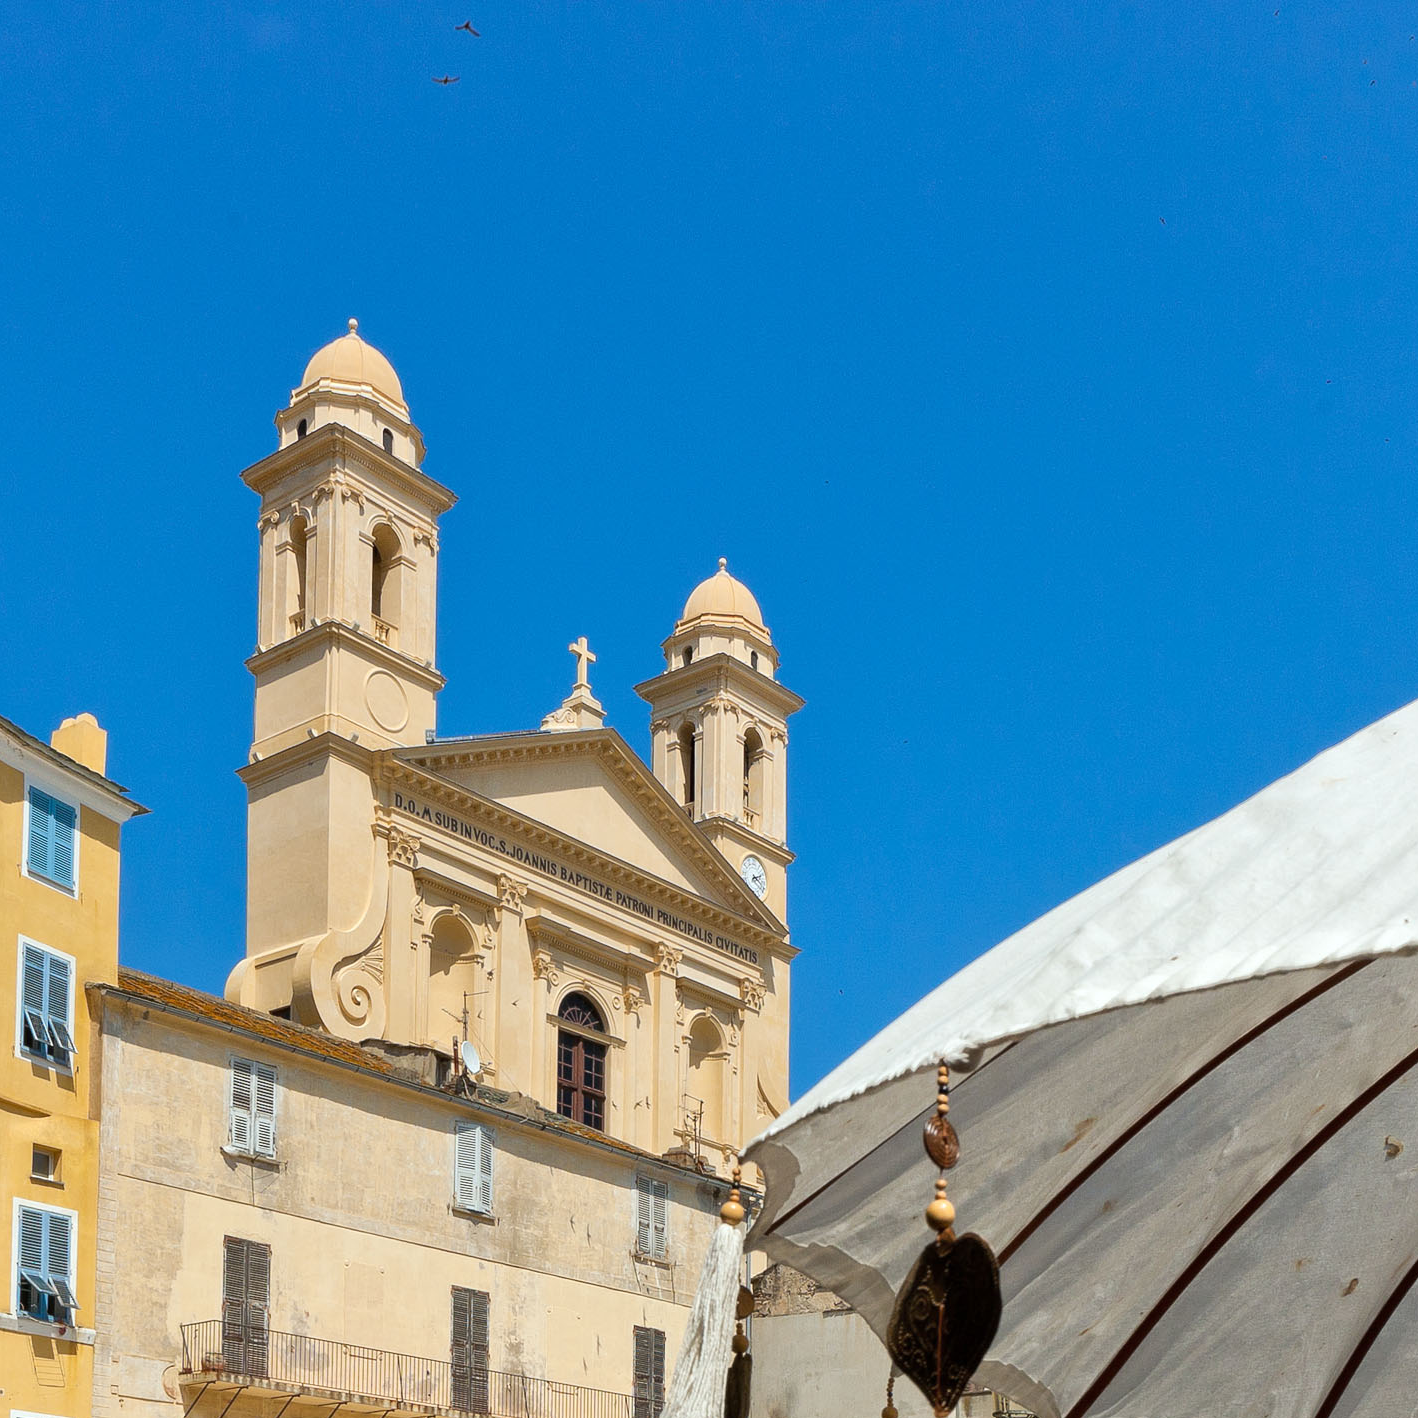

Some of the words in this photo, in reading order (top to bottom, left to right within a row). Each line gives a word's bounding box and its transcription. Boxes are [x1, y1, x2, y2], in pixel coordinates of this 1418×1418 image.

[434, 812, 458, 833] SUB
[616, 890, 654, 917] PATRONI
[657, 909, 713, 946] PRINCIPALIS
[715, 935, 758, 965] CIVITATIS
